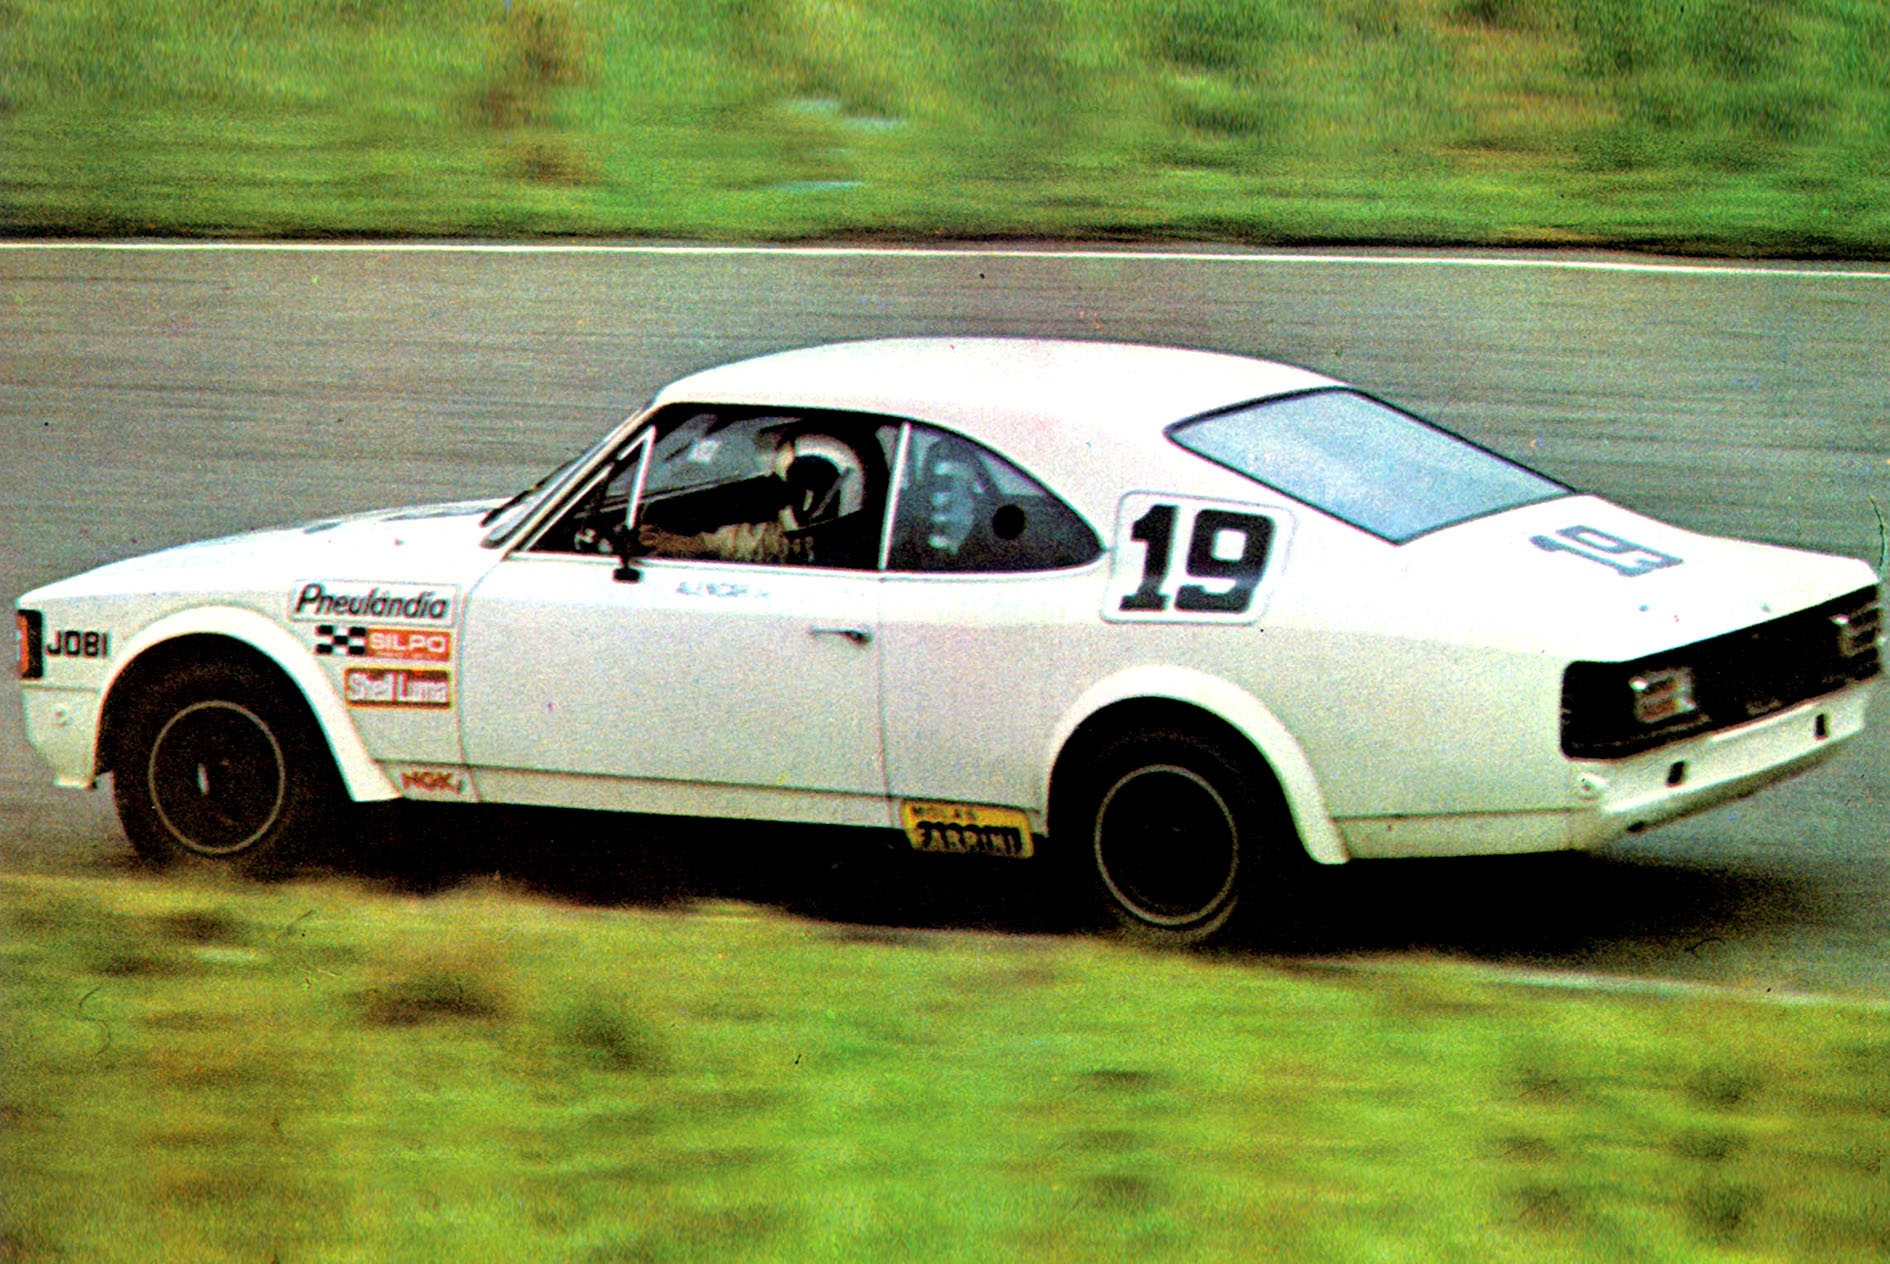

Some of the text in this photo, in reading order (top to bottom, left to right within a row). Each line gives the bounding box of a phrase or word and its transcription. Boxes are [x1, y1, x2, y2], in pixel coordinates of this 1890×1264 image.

[1119, 504, 1275, 613] 19
[1530, 525, 1685, 577] 19
[45, 630, 107, 658] JOBI
[369, 633, 446, 653] SILPO
